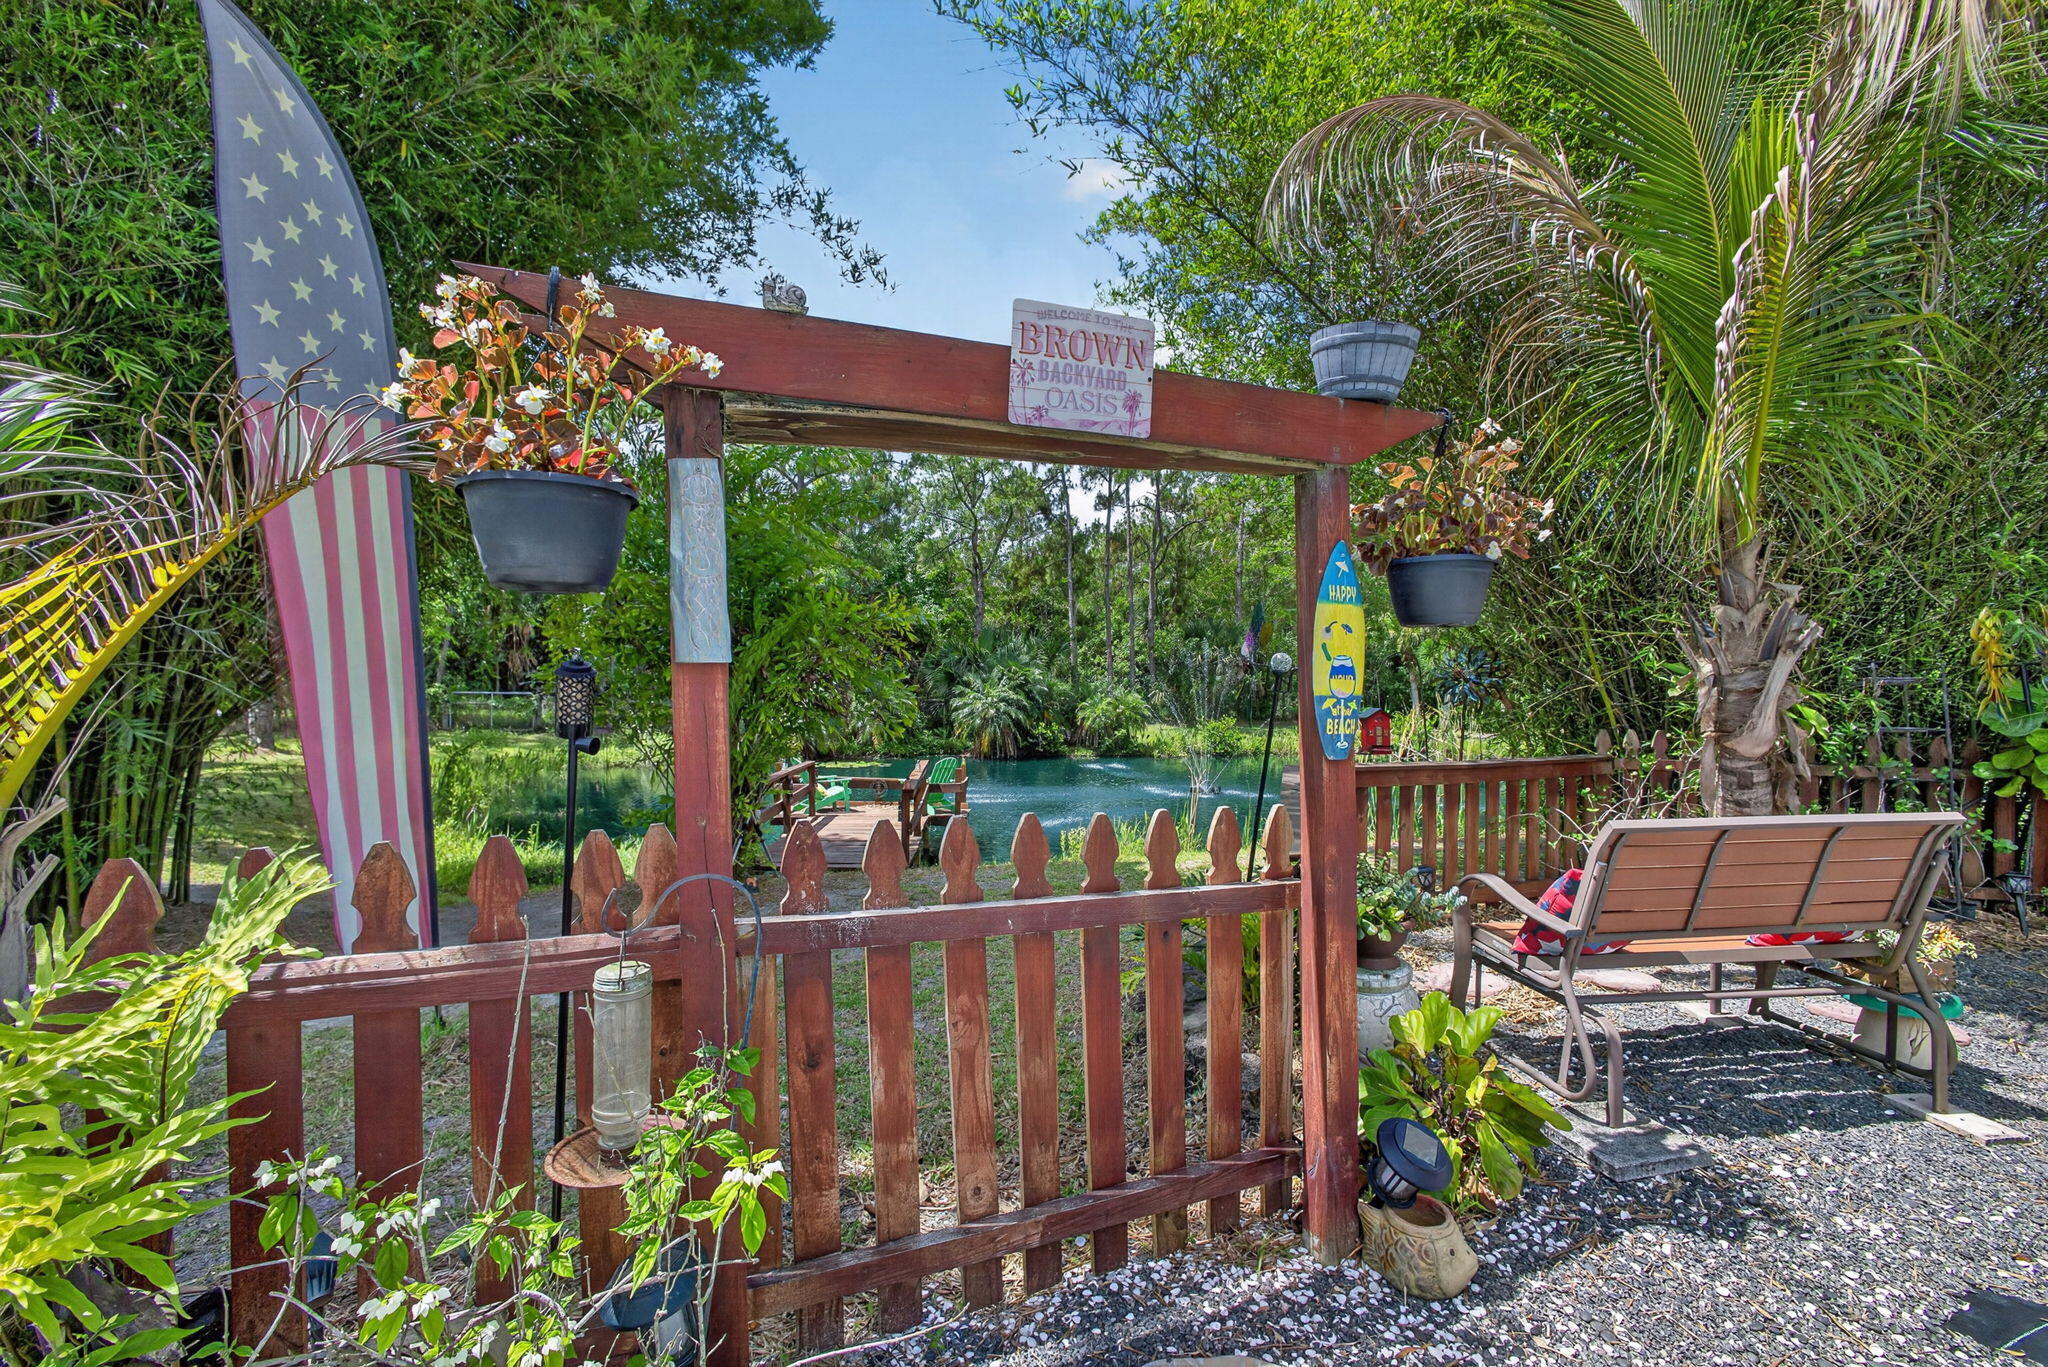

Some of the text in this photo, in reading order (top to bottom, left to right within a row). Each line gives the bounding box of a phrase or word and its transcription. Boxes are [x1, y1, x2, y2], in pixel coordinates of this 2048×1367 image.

[1037, 309, 1092, 322] WELCOME
[1094, 314, 1111, 326] TO
[1019, 321, 1151, 372] BROWN
[1038, 360, 1127, 391] BACKYARD
[1045, 387, 1118, 415] OASIS
[1329, 584, 1357, 603] HAPPY
[1326, 718, 1356, 735] BEACH
